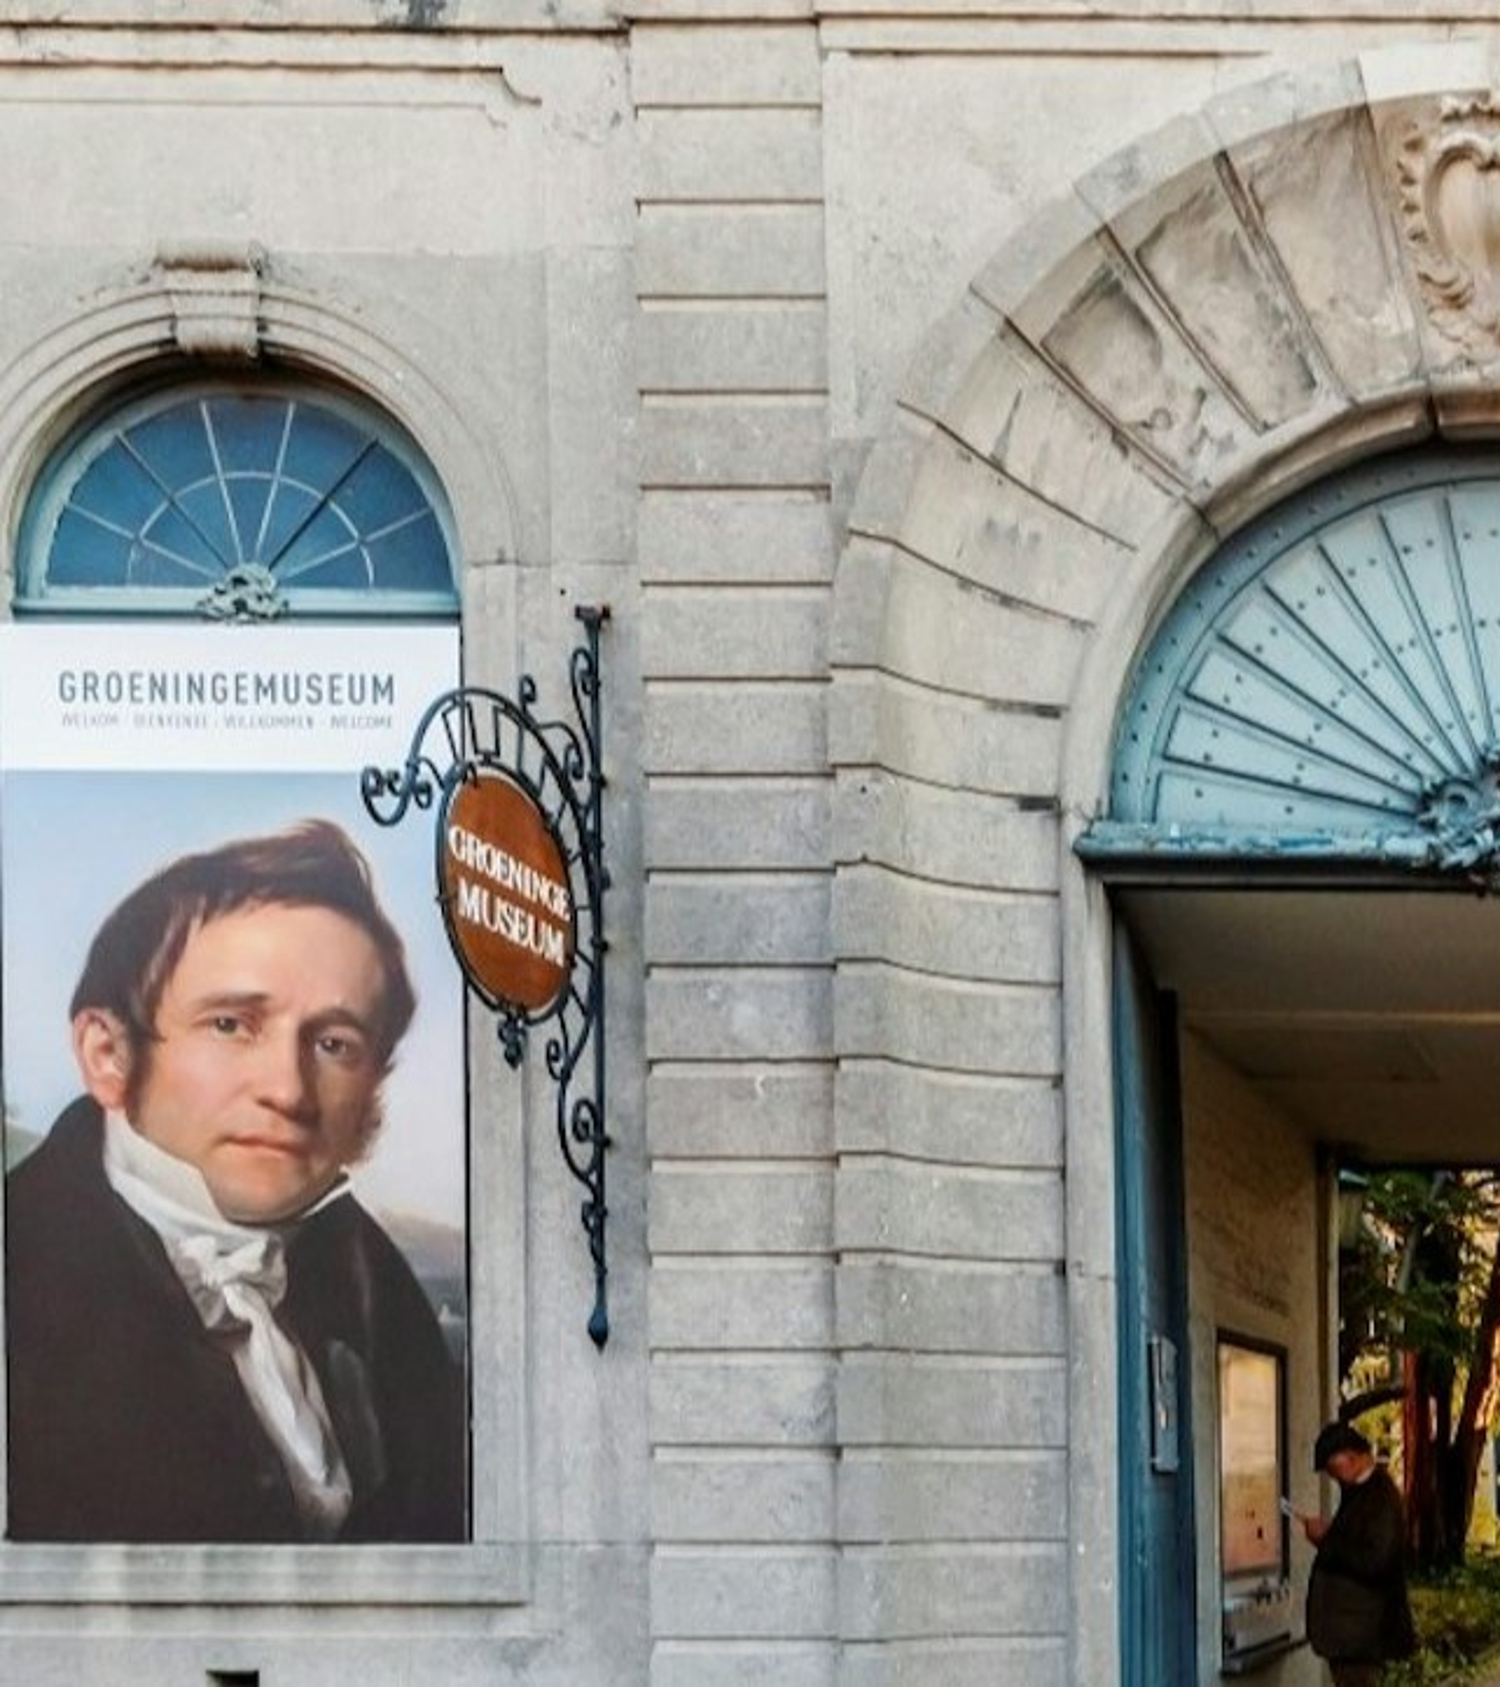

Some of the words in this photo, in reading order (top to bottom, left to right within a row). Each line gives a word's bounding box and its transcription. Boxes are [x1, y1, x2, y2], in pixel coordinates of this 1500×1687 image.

[59, 670, 395, 705] GROENINGEMUSEUM
[449, 825, 571, 921] GROENINGE
[458, 877, 565, 967] MUSEUM
